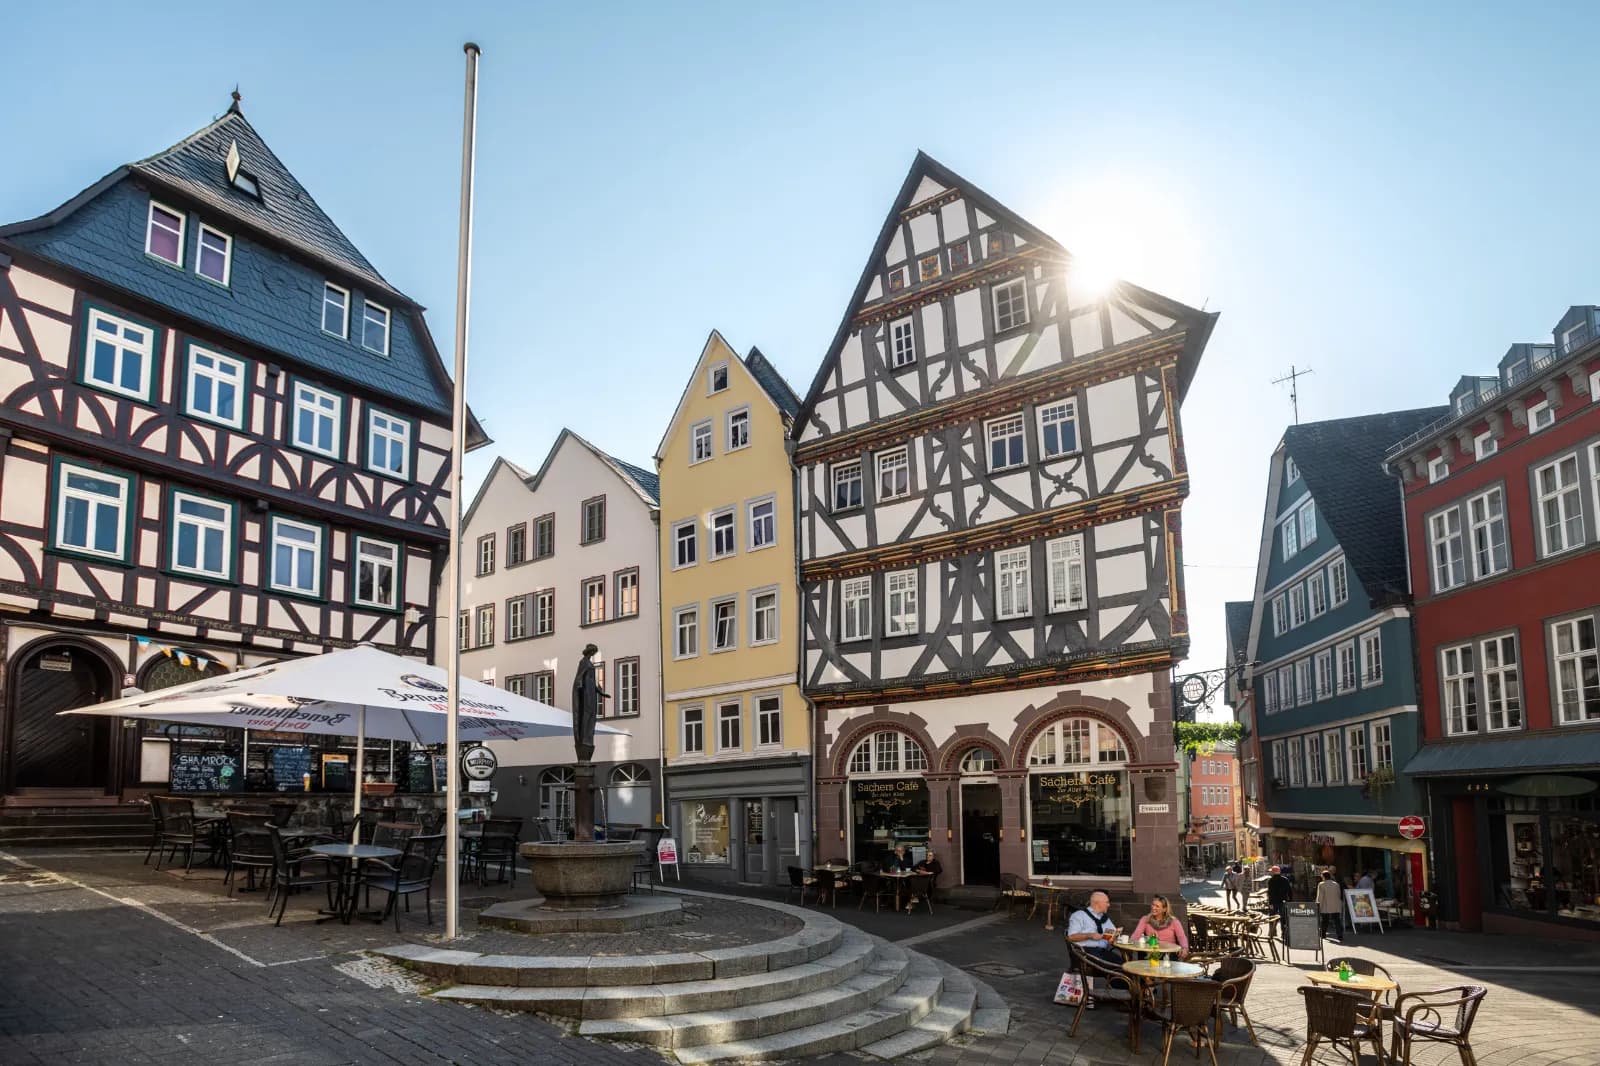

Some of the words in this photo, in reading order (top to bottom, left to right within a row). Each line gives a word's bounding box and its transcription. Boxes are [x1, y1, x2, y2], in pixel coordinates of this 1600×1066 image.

[179, 755, 239, 767] SHAMROCK
[857, 783, 894, 792] Sachers
[896, 781, 919, 791] Café
[1040, 776, 1084, 787] Sachers
[1088, 774, 1116, 785] Café
